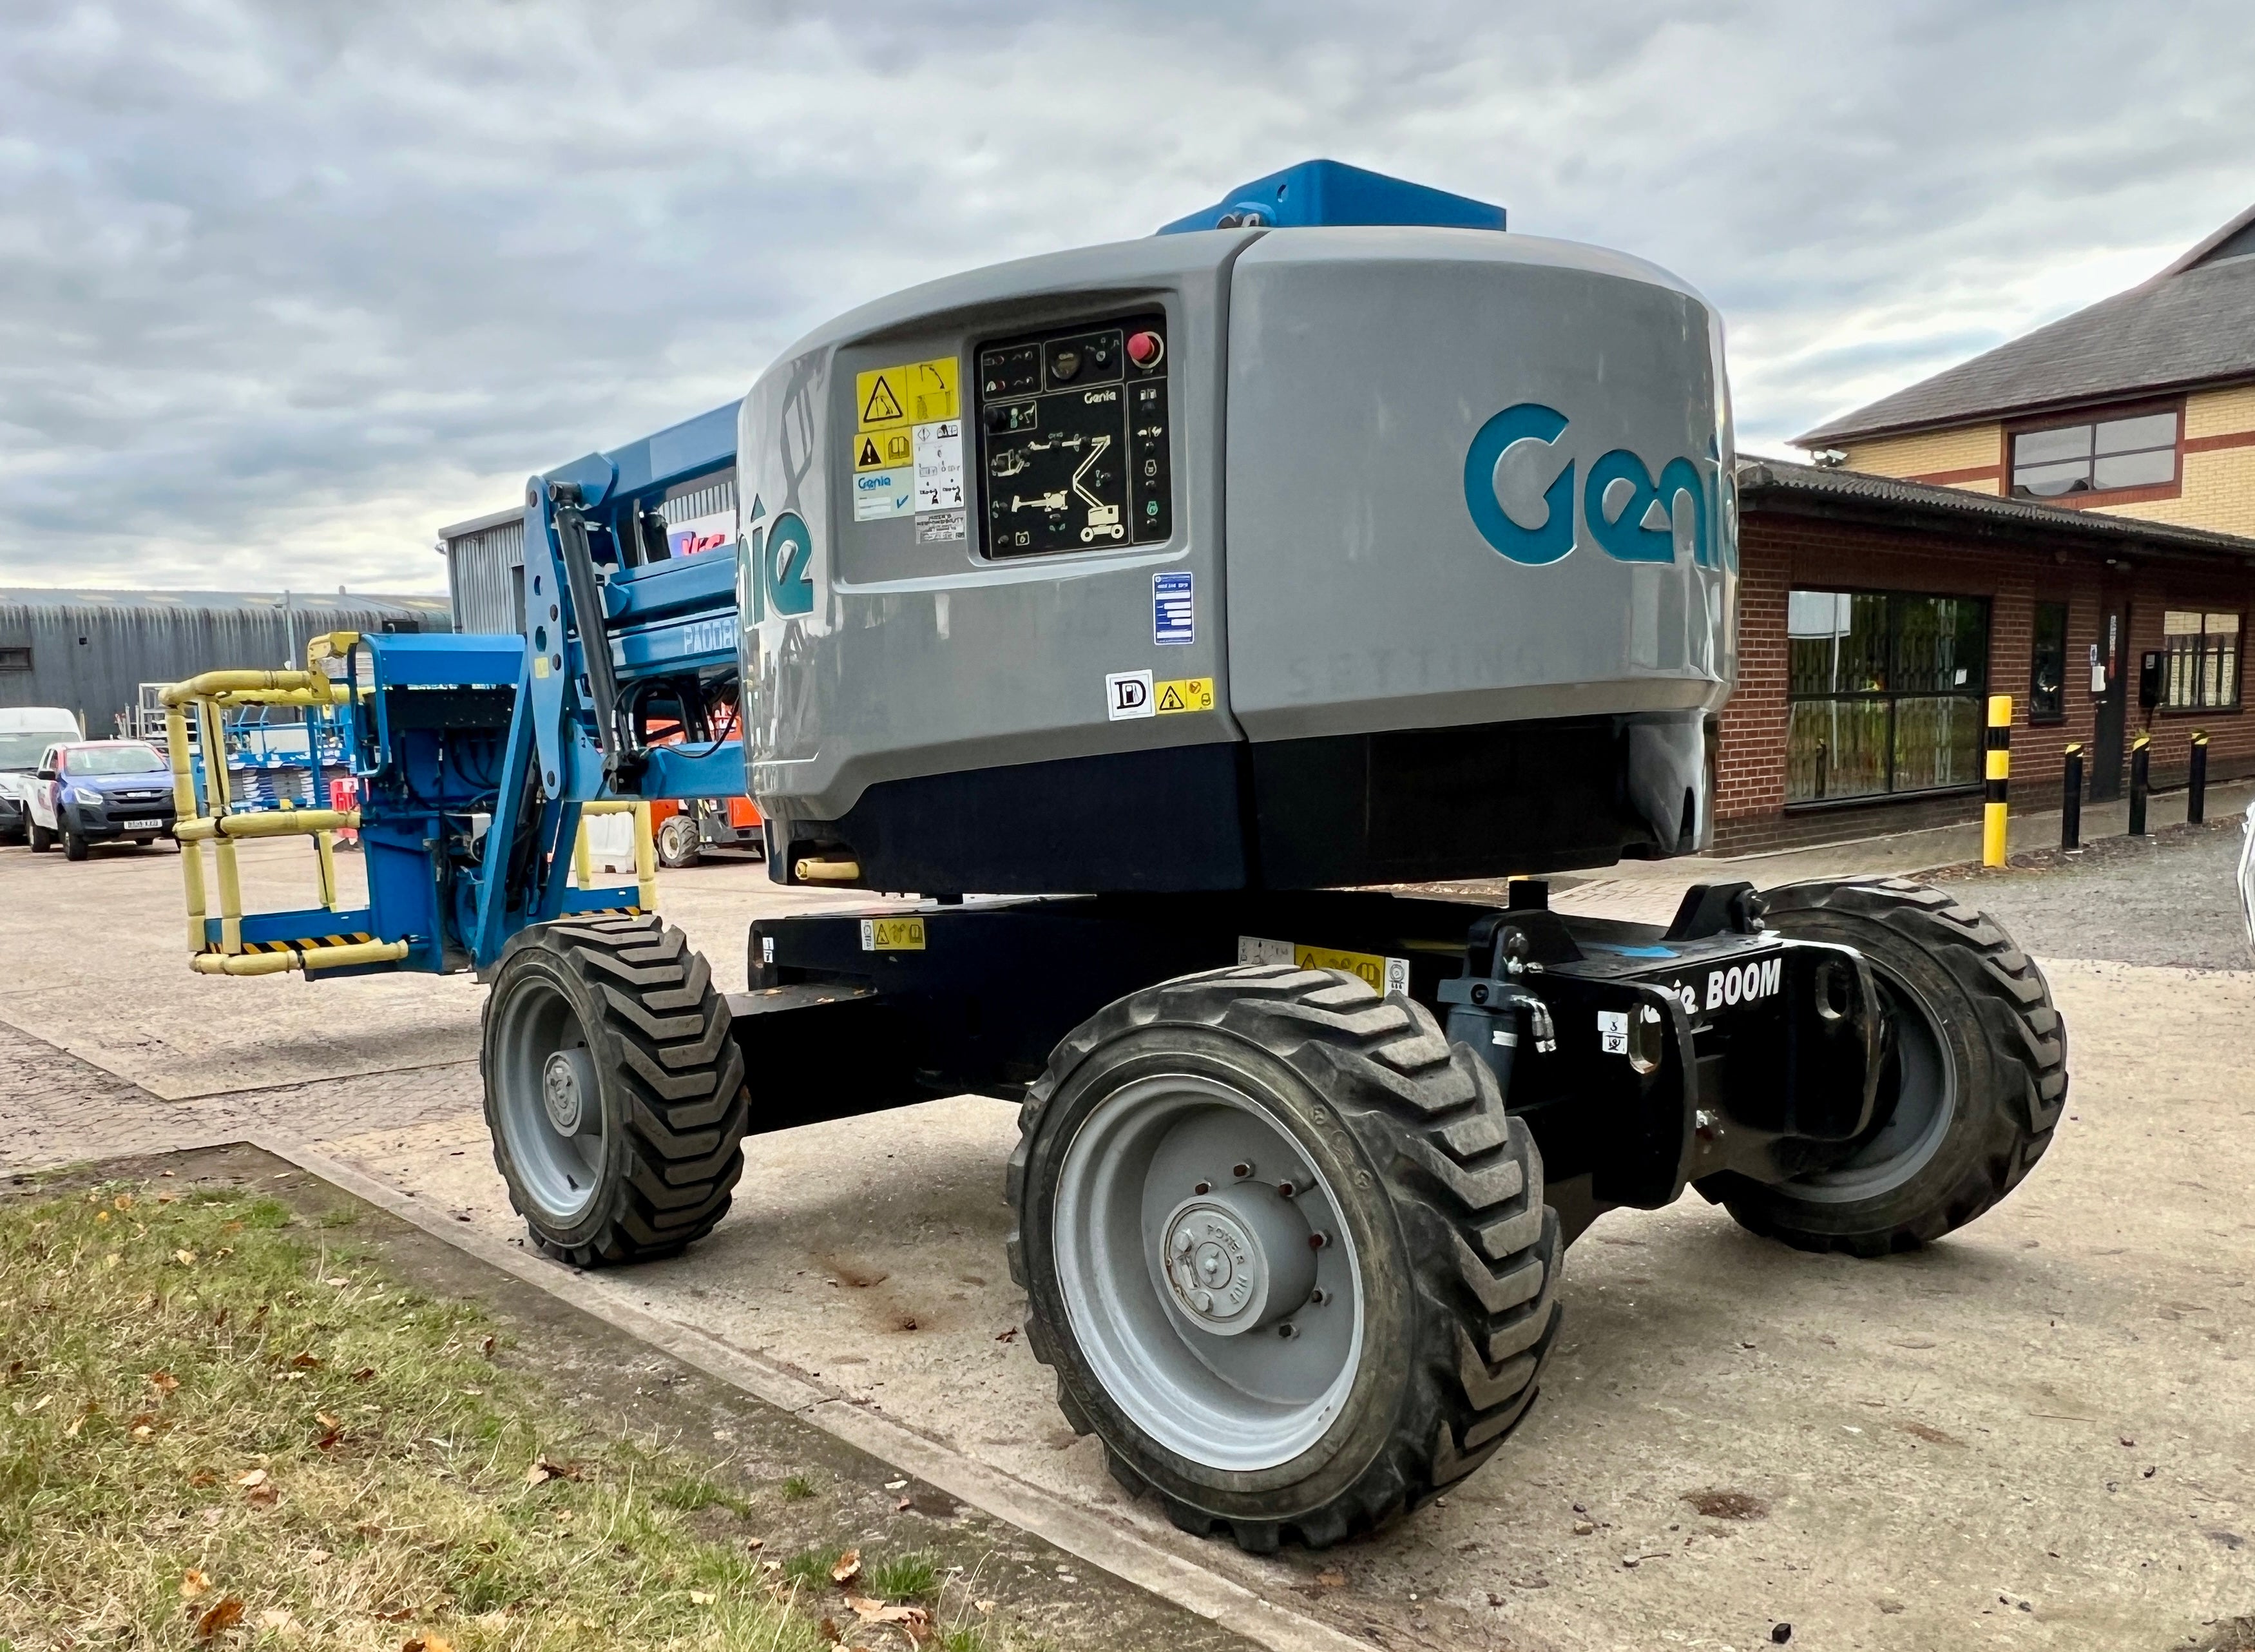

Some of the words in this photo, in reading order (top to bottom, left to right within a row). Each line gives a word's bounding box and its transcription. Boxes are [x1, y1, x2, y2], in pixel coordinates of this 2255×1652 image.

[1084, 390, 1117, 404] Genie
[858, 475, 891, 490] Genie
[1705, 957, 1782, 1010] BOOM
